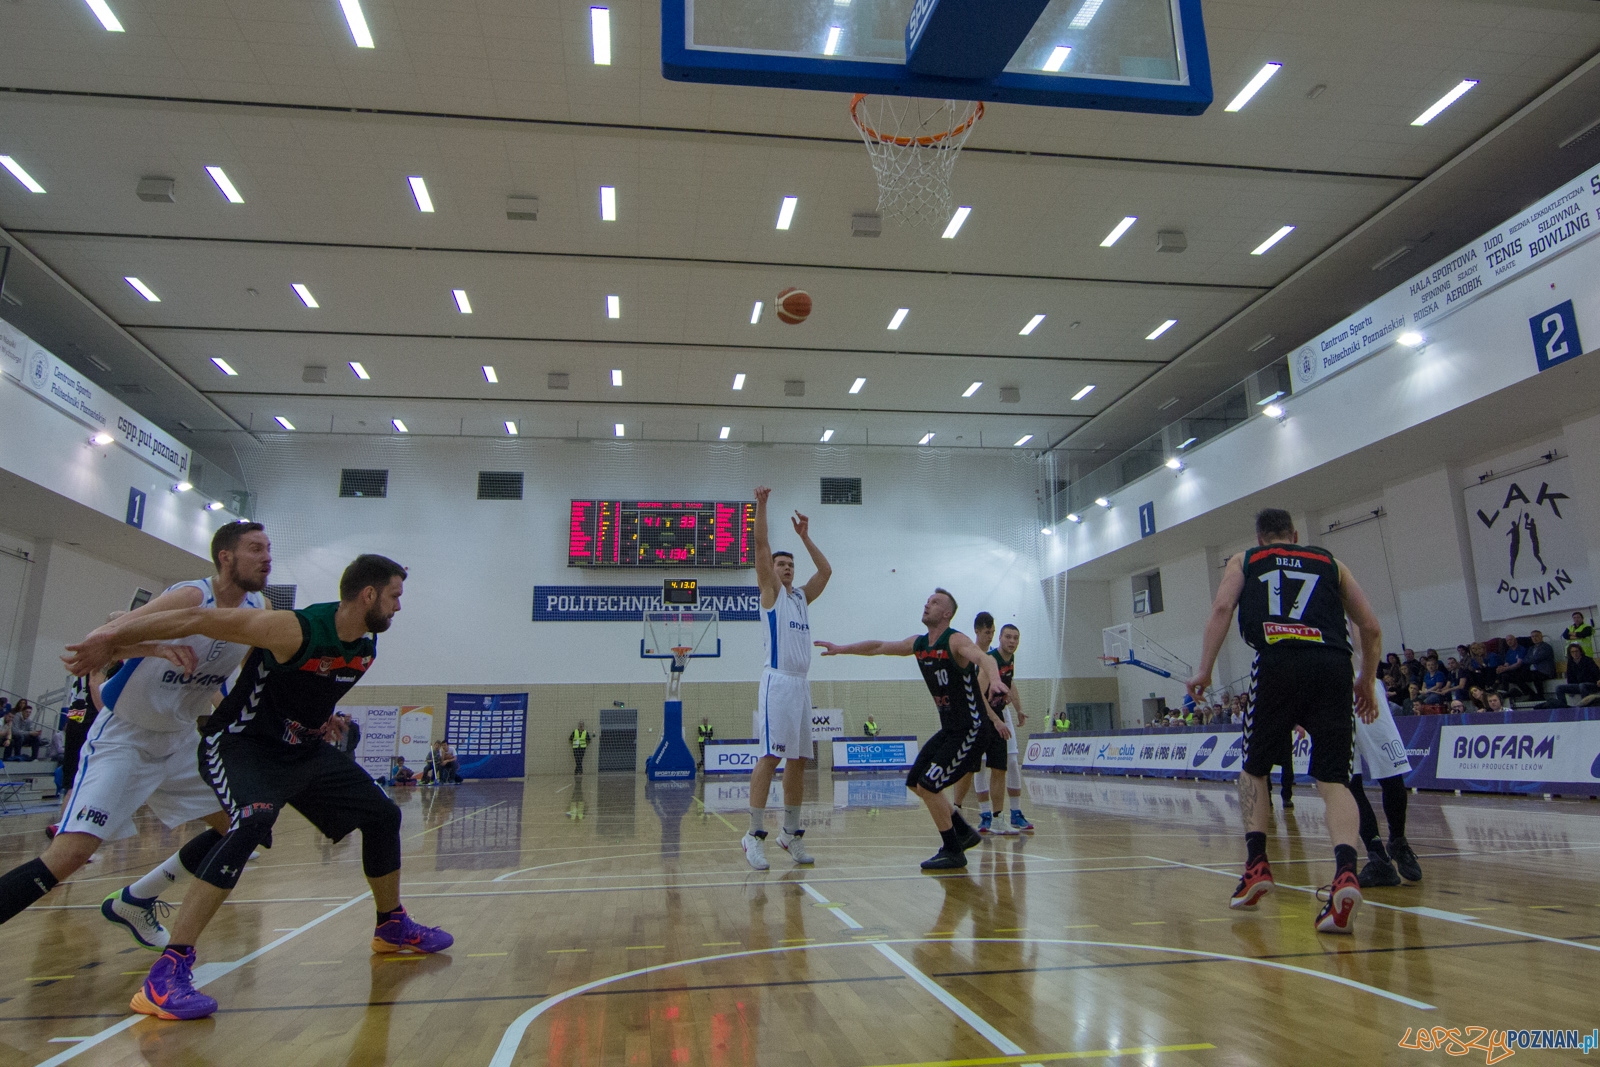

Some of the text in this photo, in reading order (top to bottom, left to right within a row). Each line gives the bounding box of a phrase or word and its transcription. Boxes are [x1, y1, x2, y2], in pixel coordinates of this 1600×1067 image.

[1538, 202, 1581, 233] SIŁOWNIA
[1483, 233, 1503, 252] JUDO
[1529, 212, 1590, 258] BOWLING
[1485, 237, 1523, 269] TENIS
[1409, 249, 1477, 296] HALA SPORTOWA
[1457, 264, 1478, 281] SZACHY
[1495, 260, 1516, 276] KARATE
[1446, 275, 1482, 305] AEROBIK
[1413, 301, 1439, 322] BOISKA
[1321, 316, 1373, 352] Centrum Sportu
[1323, 314, 1406, 368] Politechniki Poznańskiej
[1542, 313, 1569, 360] 2
[54, 366, 76, 389] Centrum
[117, 416, 188, 472] cspp.put.poznan.pl
[133, 494, 140, 524] 1
[644, 517, 660, 527] 41
[680, 516, 695, 528] 33
[1142, 508, 1150, 533] 1
[1275, 557, 1302, 568] DEJA
[1258, 569, 1320, 620] 17
[1497, 568, 1573, 606] POZNAŃ
[1266, 625, 1320, 634] KREDYTY
[934, 669, 949, 686] 10
[1062, 743, 1091, 755] BIOFARM
[1381, 740, 1405, 761] 10
[1453, 735, 1555, 759] BIOFARM
[718, 753, 758, 765] POZn
[1521, 763, 1544, 771] LEKÓW
[925, 763, 943, 781] 10
[85, 809, 108, 827] PBG
